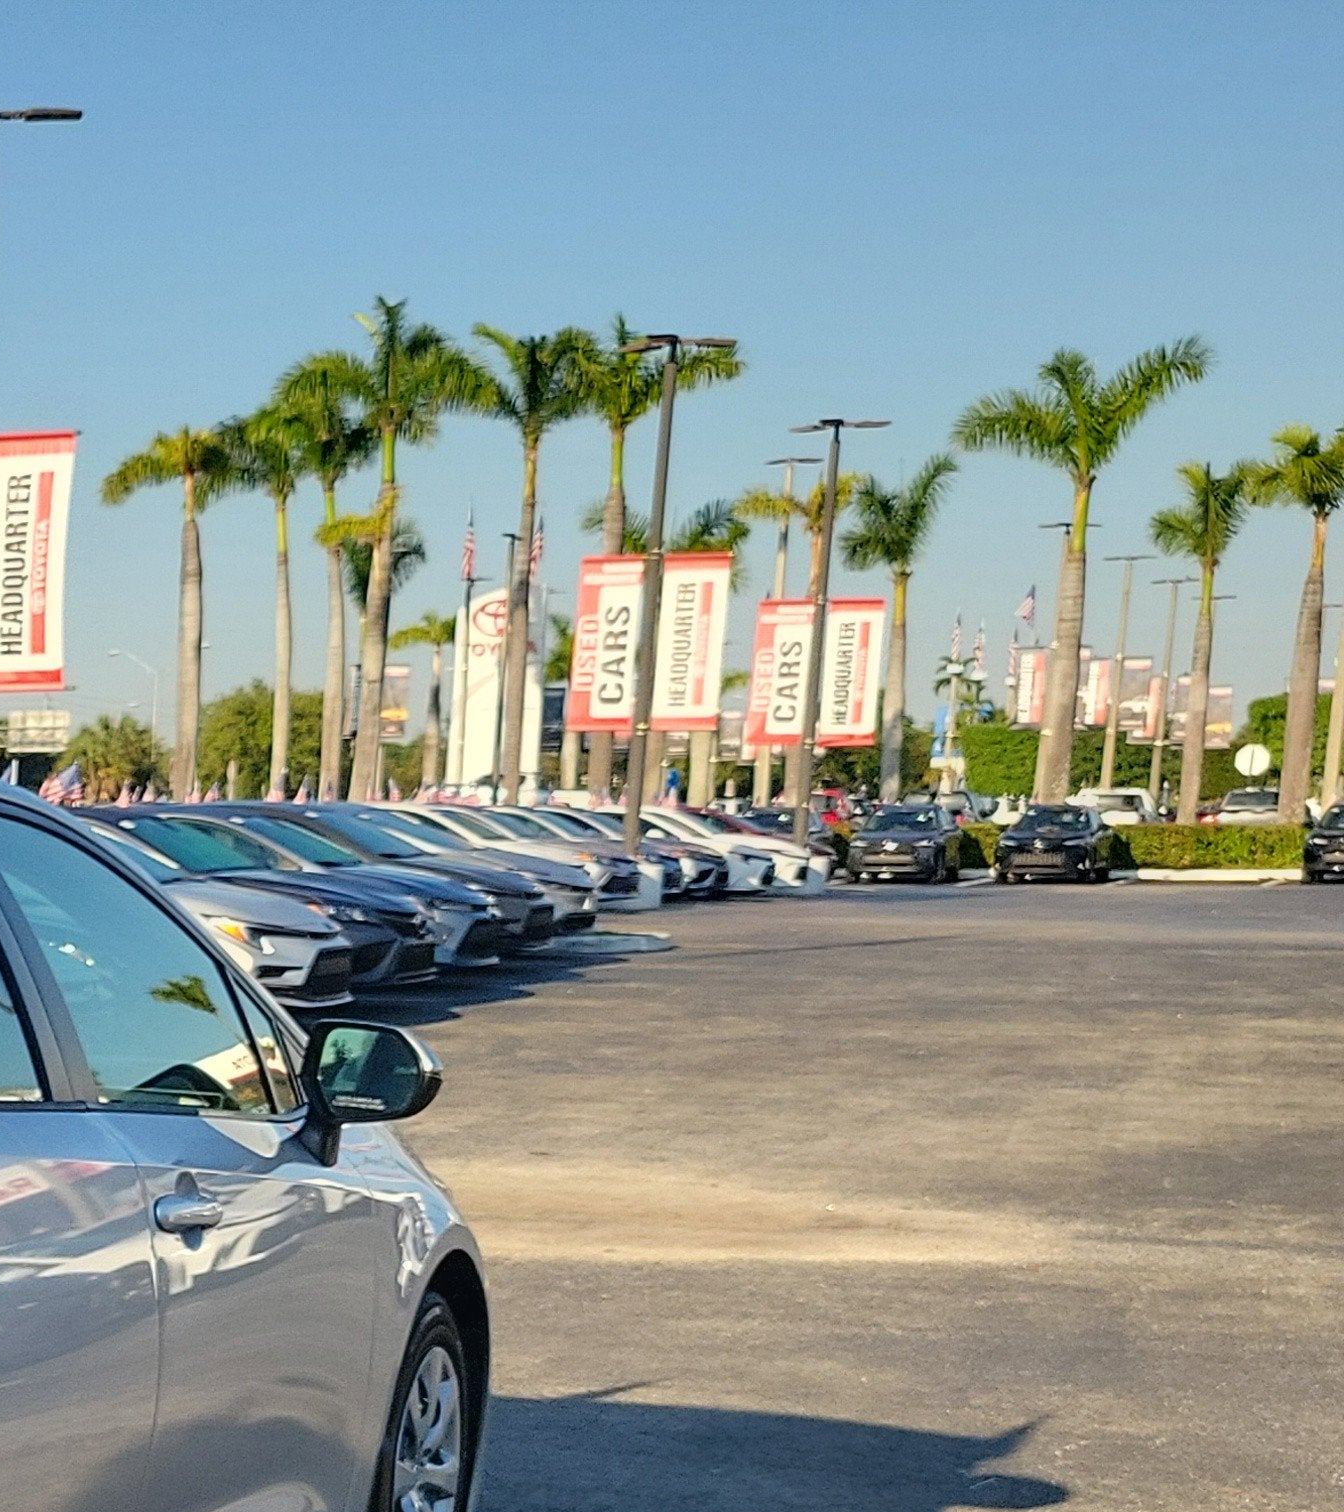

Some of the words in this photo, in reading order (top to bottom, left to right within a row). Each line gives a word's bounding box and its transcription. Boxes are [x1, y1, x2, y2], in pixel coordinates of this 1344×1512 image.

[0, 473, 33, 656] HEADQUARTER
[576, 619, 599, 688] USED
[598, 605, 631, 705] CARS
[667, 582, 697, 707] HEADQUARTER
[773, 641, 803, 723] CARS
[831, 622, 856, 726] HEADQUARTER
